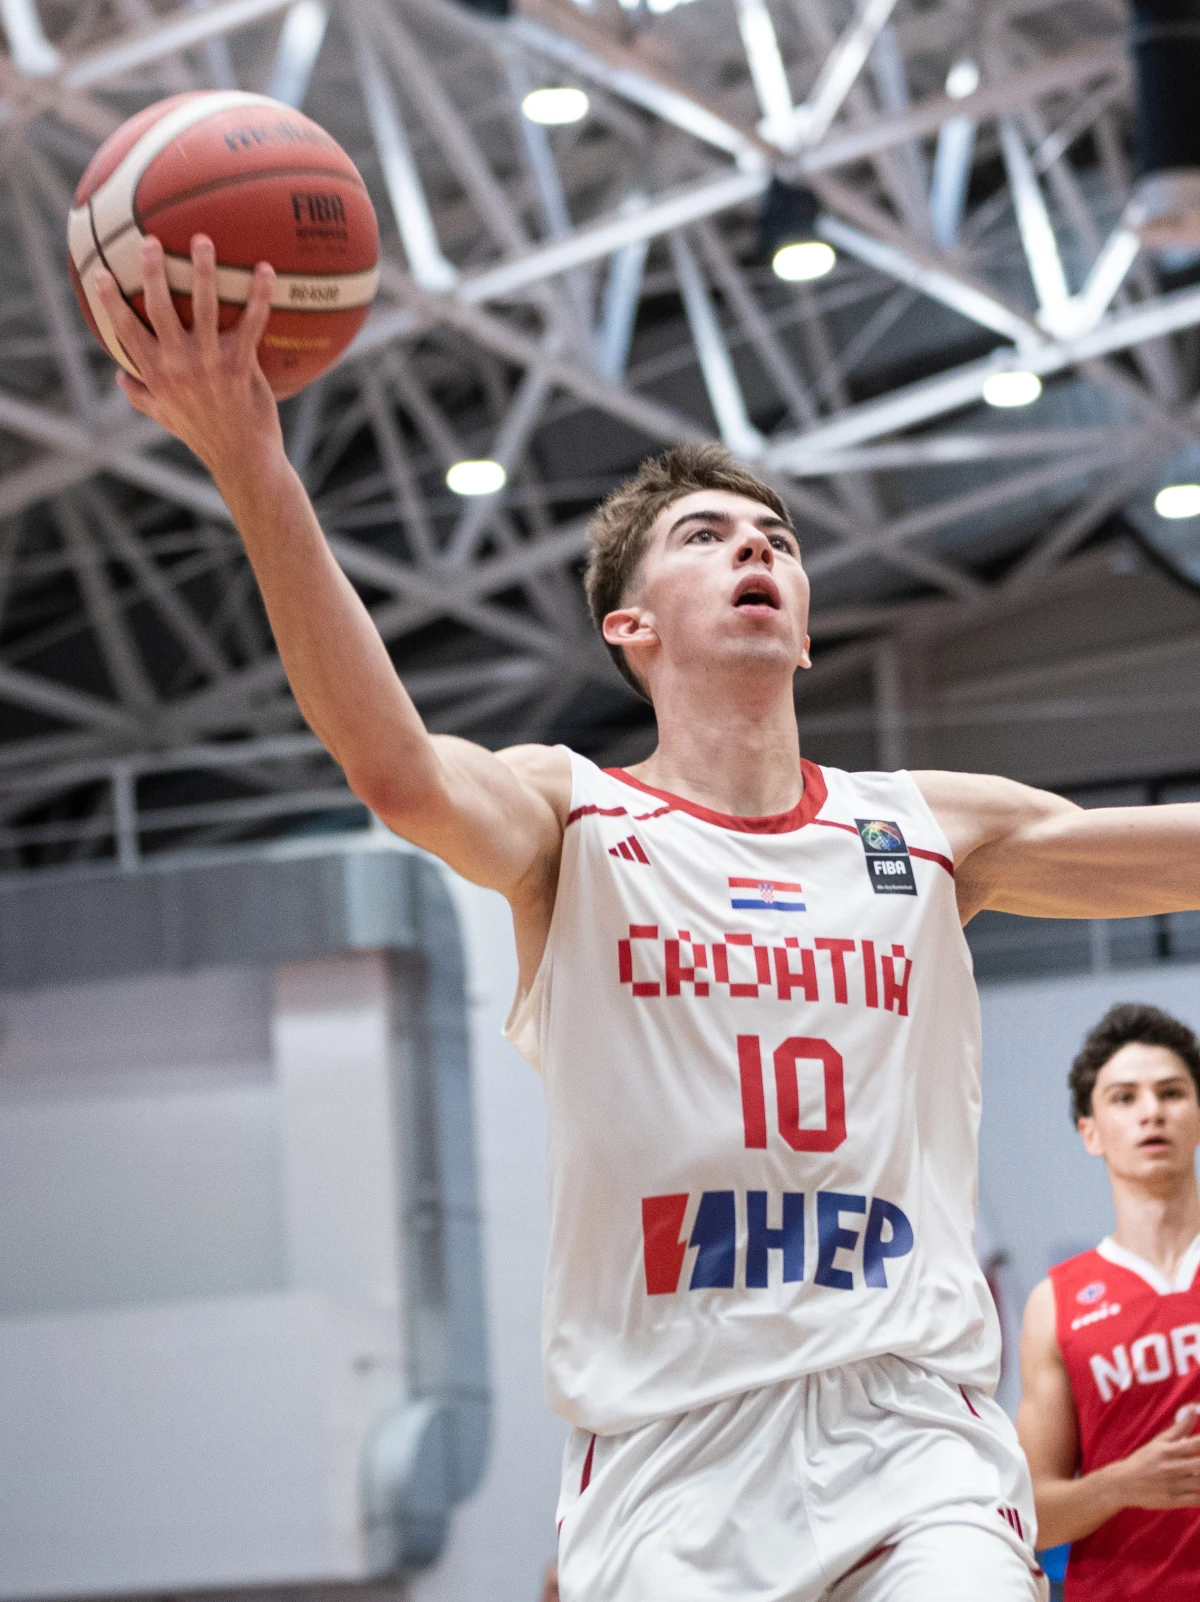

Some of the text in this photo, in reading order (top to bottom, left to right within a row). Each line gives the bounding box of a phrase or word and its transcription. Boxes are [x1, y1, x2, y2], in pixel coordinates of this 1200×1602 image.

[873, 860, 907, 875] FIBA
[617, 924, 913, 1017] CROATIA
[736, 1034, 848, 1153] 10
[745, 1190, 915, 1291] HEP
